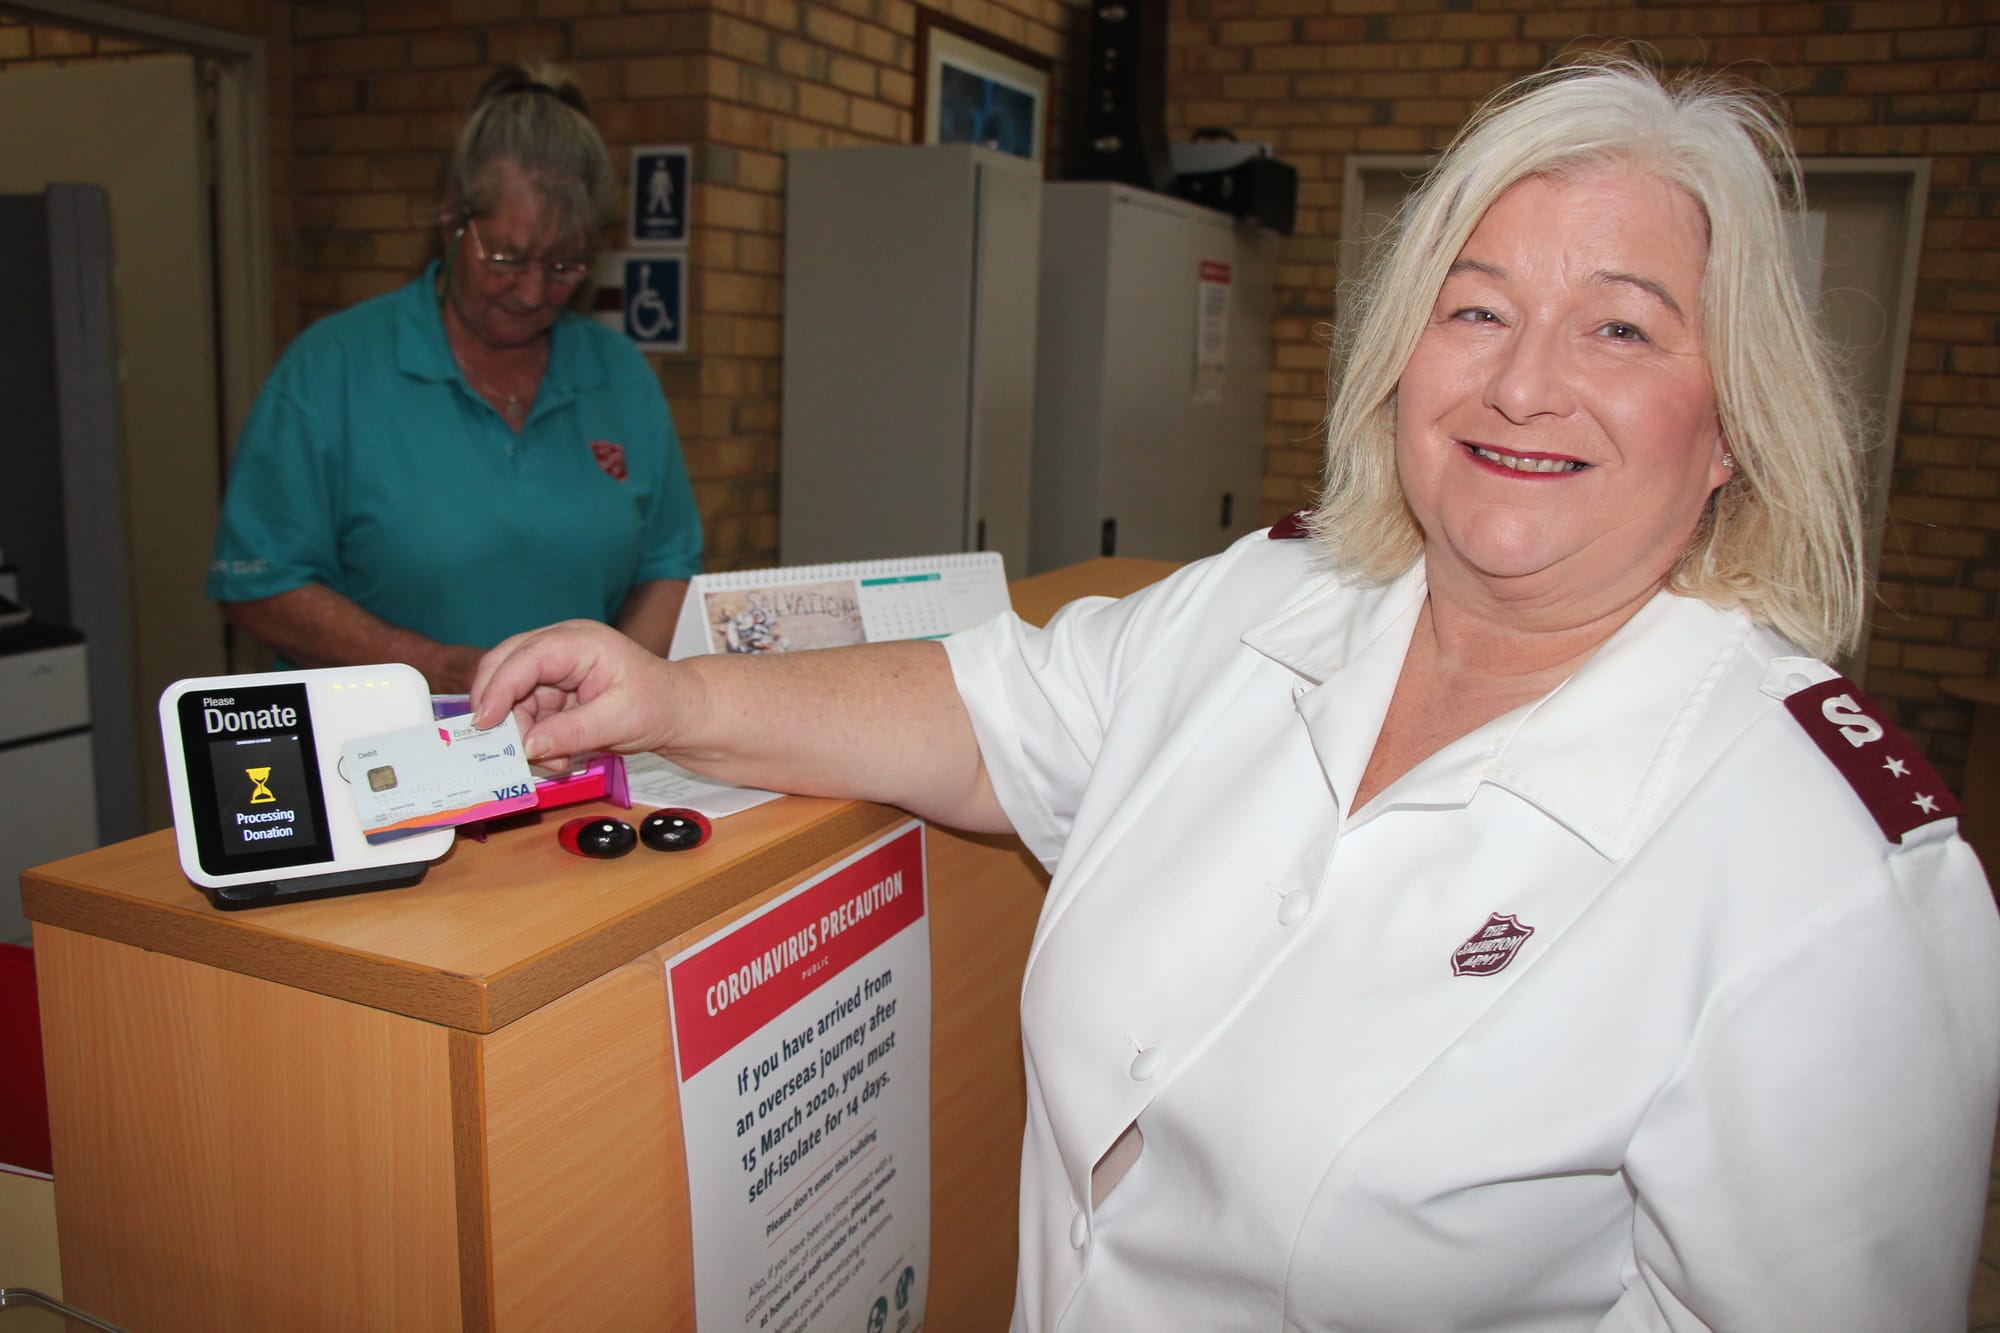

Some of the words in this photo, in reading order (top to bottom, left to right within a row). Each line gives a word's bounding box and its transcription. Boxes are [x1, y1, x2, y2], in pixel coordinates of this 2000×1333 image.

[203, 697, 235, 707] Please
[204, 704, 297, 733] Donate
[1821, 693, 1884, 748] S
[357, 749, 378, 760] Debit
[492, 783, 531, 801] VISA
[236, 809, 295, 825] Processing
[243, 826, 293, 841] Donation
[706, 923, 818, 1017] CORONAVIRUS
[821, 870, 903, 944] PRECAUTION
[1481, 923, 1510, 939] THE
[802, 956, 830, 980] PUBLIC
[1460, 952, 1505, 968] ARMY
[737, 1067, 748, 1096] If
[753, 1052, 779, 1091] you
[783, 1026, 814, 1061] have
[818, 985, 861, 1036] arrived
[865, 968, 892, 1001] from
[737, 1111, 754, 1137] an
[759, 1061, 816, 1119] overseas
[821, 1022, 866, 1079] journey
[870, 999, 897, 1032] after
[742, 1148, 757, 1173] 15
[761, 1106, 802, 1156] March
[806, 1082, 839, 1119] 2020,
[843, 1062, 864, 1094] you
[868, 1031, 895, 1067] must
[749, 1127, 821, 1203] self-isolate
[825, 1106, 843, 1140] for
[847, 1096, 858, 1120] 14
[862, 1071, 890, 1105] days.
[766, 1208, 792, 1238] Please
[793, 1187, 813, 1211] don't
[815, 1168, 834, 1192] enter
[835, 1155, 848, 1173] this
[850, 1129, 877, 1159] building
[770, 1291, 791, 1318] home
